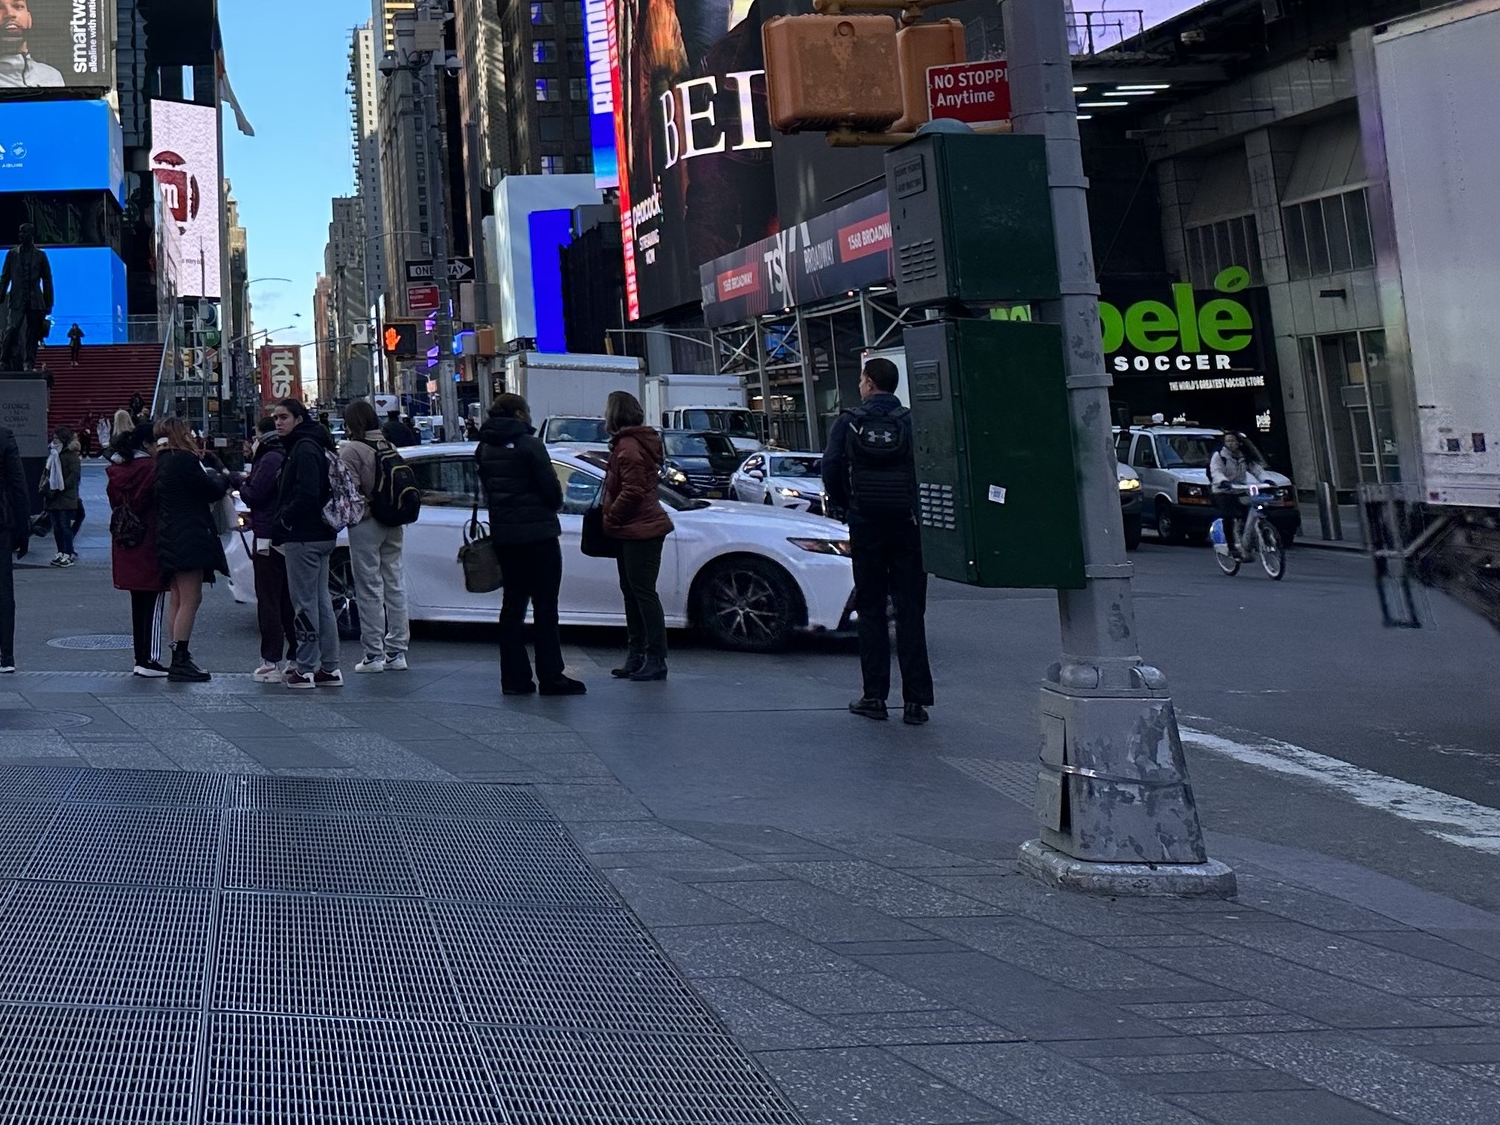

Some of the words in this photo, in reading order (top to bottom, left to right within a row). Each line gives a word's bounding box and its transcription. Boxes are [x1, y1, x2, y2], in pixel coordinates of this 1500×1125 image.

[88, 21, 97, 40] with
[88, 40, 97, 74] alkaline
[934, 74, 954, 89] NO
[958, 68, 1008, 87] STOPPI
[936, 89, 996, 108] Anytime
[861, 221, 893, 246] BROADWA
[803, 239, 835, 275] BROADWAY
[415, 266, 435, 275] ONE
[1114, 354, 1232, 372] SOCCER
[271, 351, 292, 399] tkts
[1169, 381, 1179, 392] THE
[1179, 380, 1199, 391] WORLD'S
[1199, 378, 1226, 390] GREATEST
[1225, 377, 1246, 388] SOCCER
[1246, 375, 1265, 387] STORE
